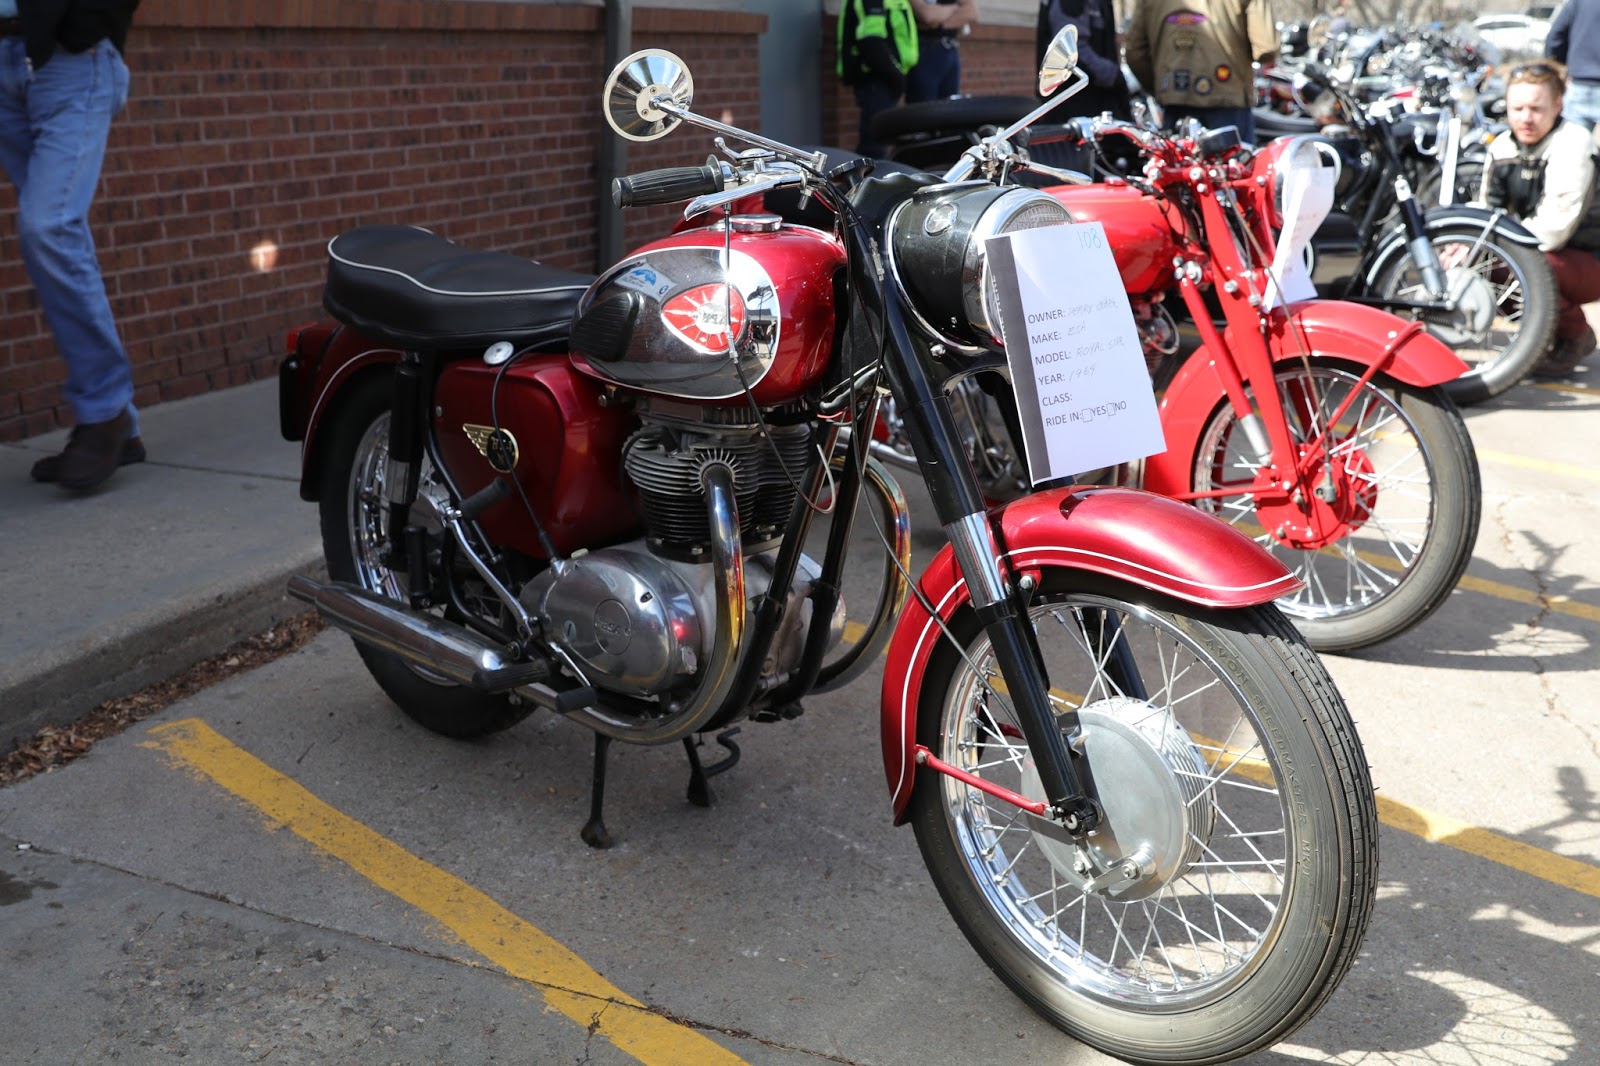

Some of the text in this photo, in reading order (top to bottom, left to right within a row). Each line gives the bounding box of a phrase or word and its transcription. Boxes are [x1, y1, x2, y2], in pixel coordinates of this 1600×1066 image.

[1077, 227, 1102, 249] 108
[1027, 309, 1067, 325] OWNER:
[1031, 331, 1062, 345] MAKE:
[1034, 350, 1072, 366] MODEL:
[1076, 340, 1105, 357] ROYAL
[1038, 372, 1066, 386] YEAR:
[1042, 392, 1073, 407] CLASS:
[1045, 400, 1127, 427] RIDE IN: YES NO
[1204, 638, 1249, 686] AVON
[1252, 693, 1308, 827] SPEEDMASTER
